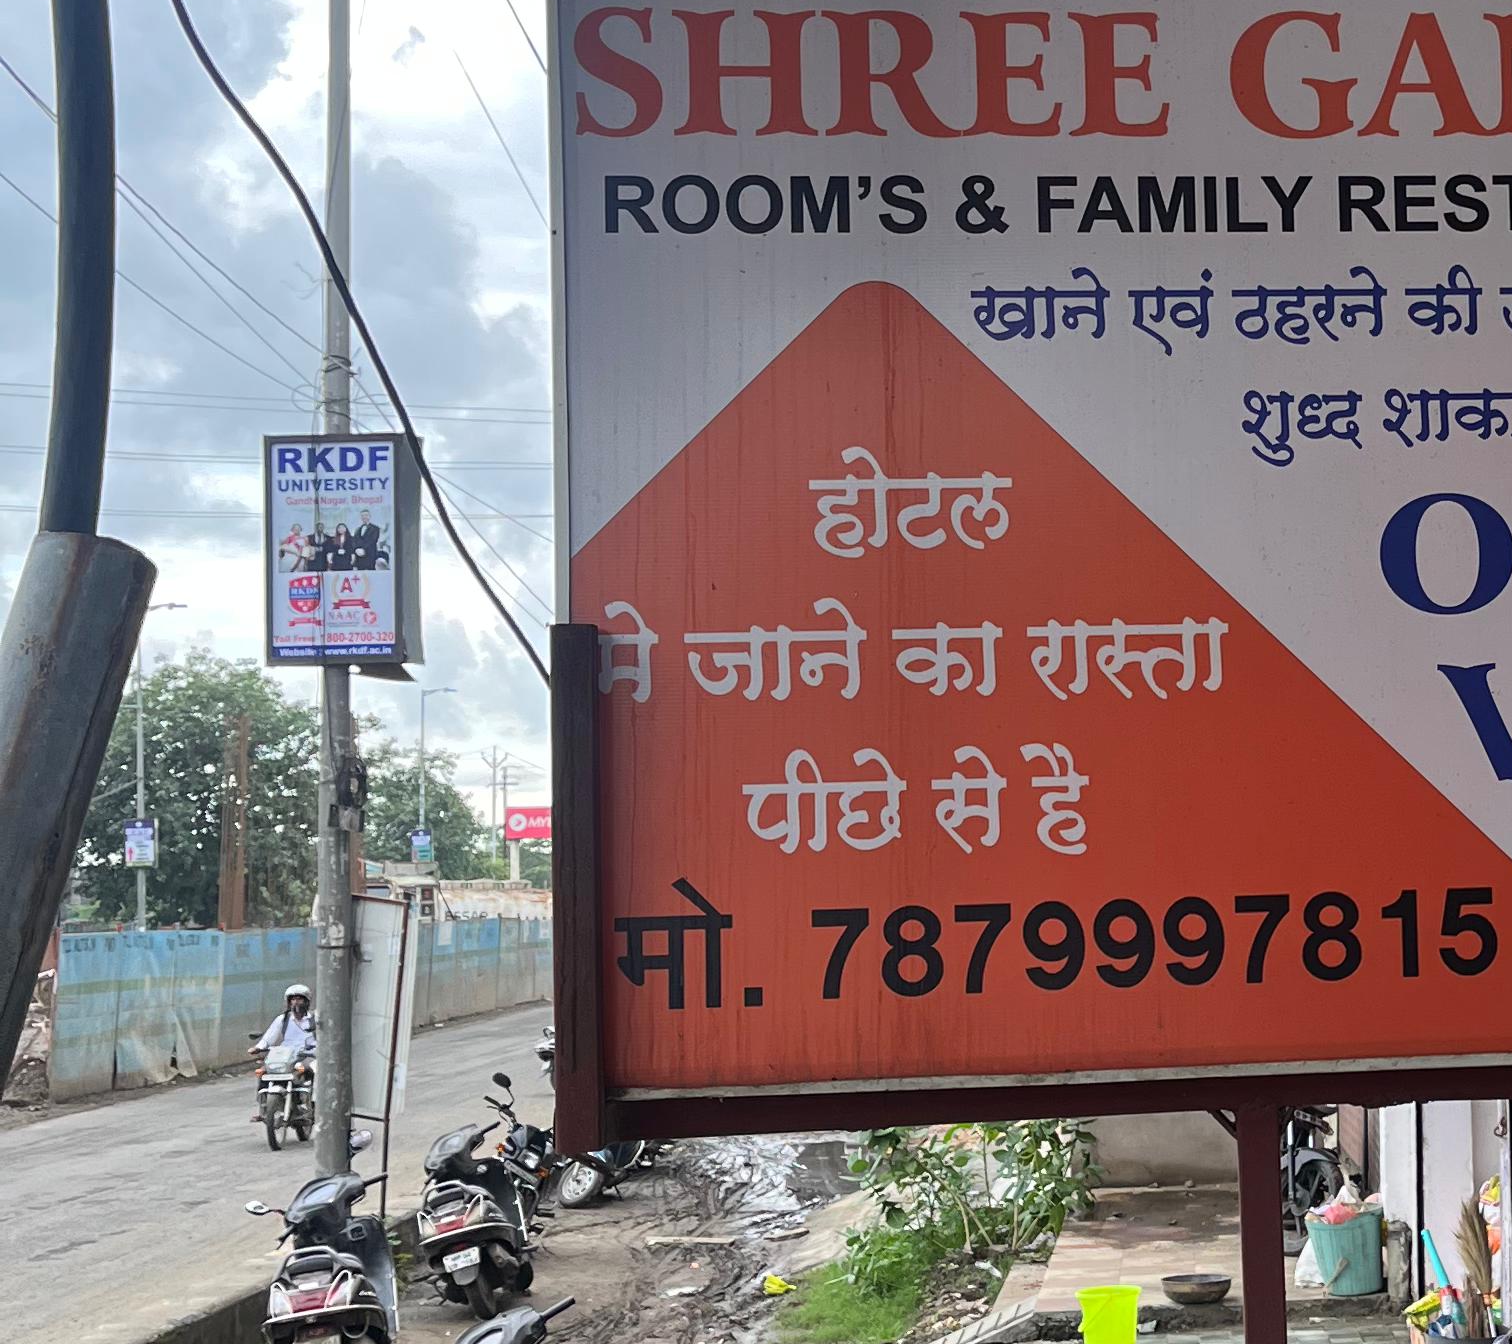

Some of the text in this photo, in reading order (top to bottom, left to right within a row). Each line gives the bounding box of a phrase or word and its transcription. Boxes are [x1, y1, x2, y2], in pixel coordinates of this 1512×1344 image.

[573, 6, 1171, 138] SHREE
[955, 174, 1009, 235] &
[1036, 175, 1313, 233] FAMILY
[970, 266, 1111, 341] खाने
[1127, 268, 1214, 357] एवं
[1231, 265, 1388, 345] ठहरने
[1404, 264, 1483, 337] की
[277, 446, 390, 474] RKDF
[277, 477, 389, 492] UNIVERSITY
[286, 497, 318, 505] Gandh
[808, 446, 1013, 558] होटल
[324, 646, 392, 656] www.rkdf.ac.in
[598, 597, 1229, 703] मे जाने का रास्ता
[742, 742, 1090, 856] पीछे से है
[614, 877, 1498, 1010] मो. 7879997815
